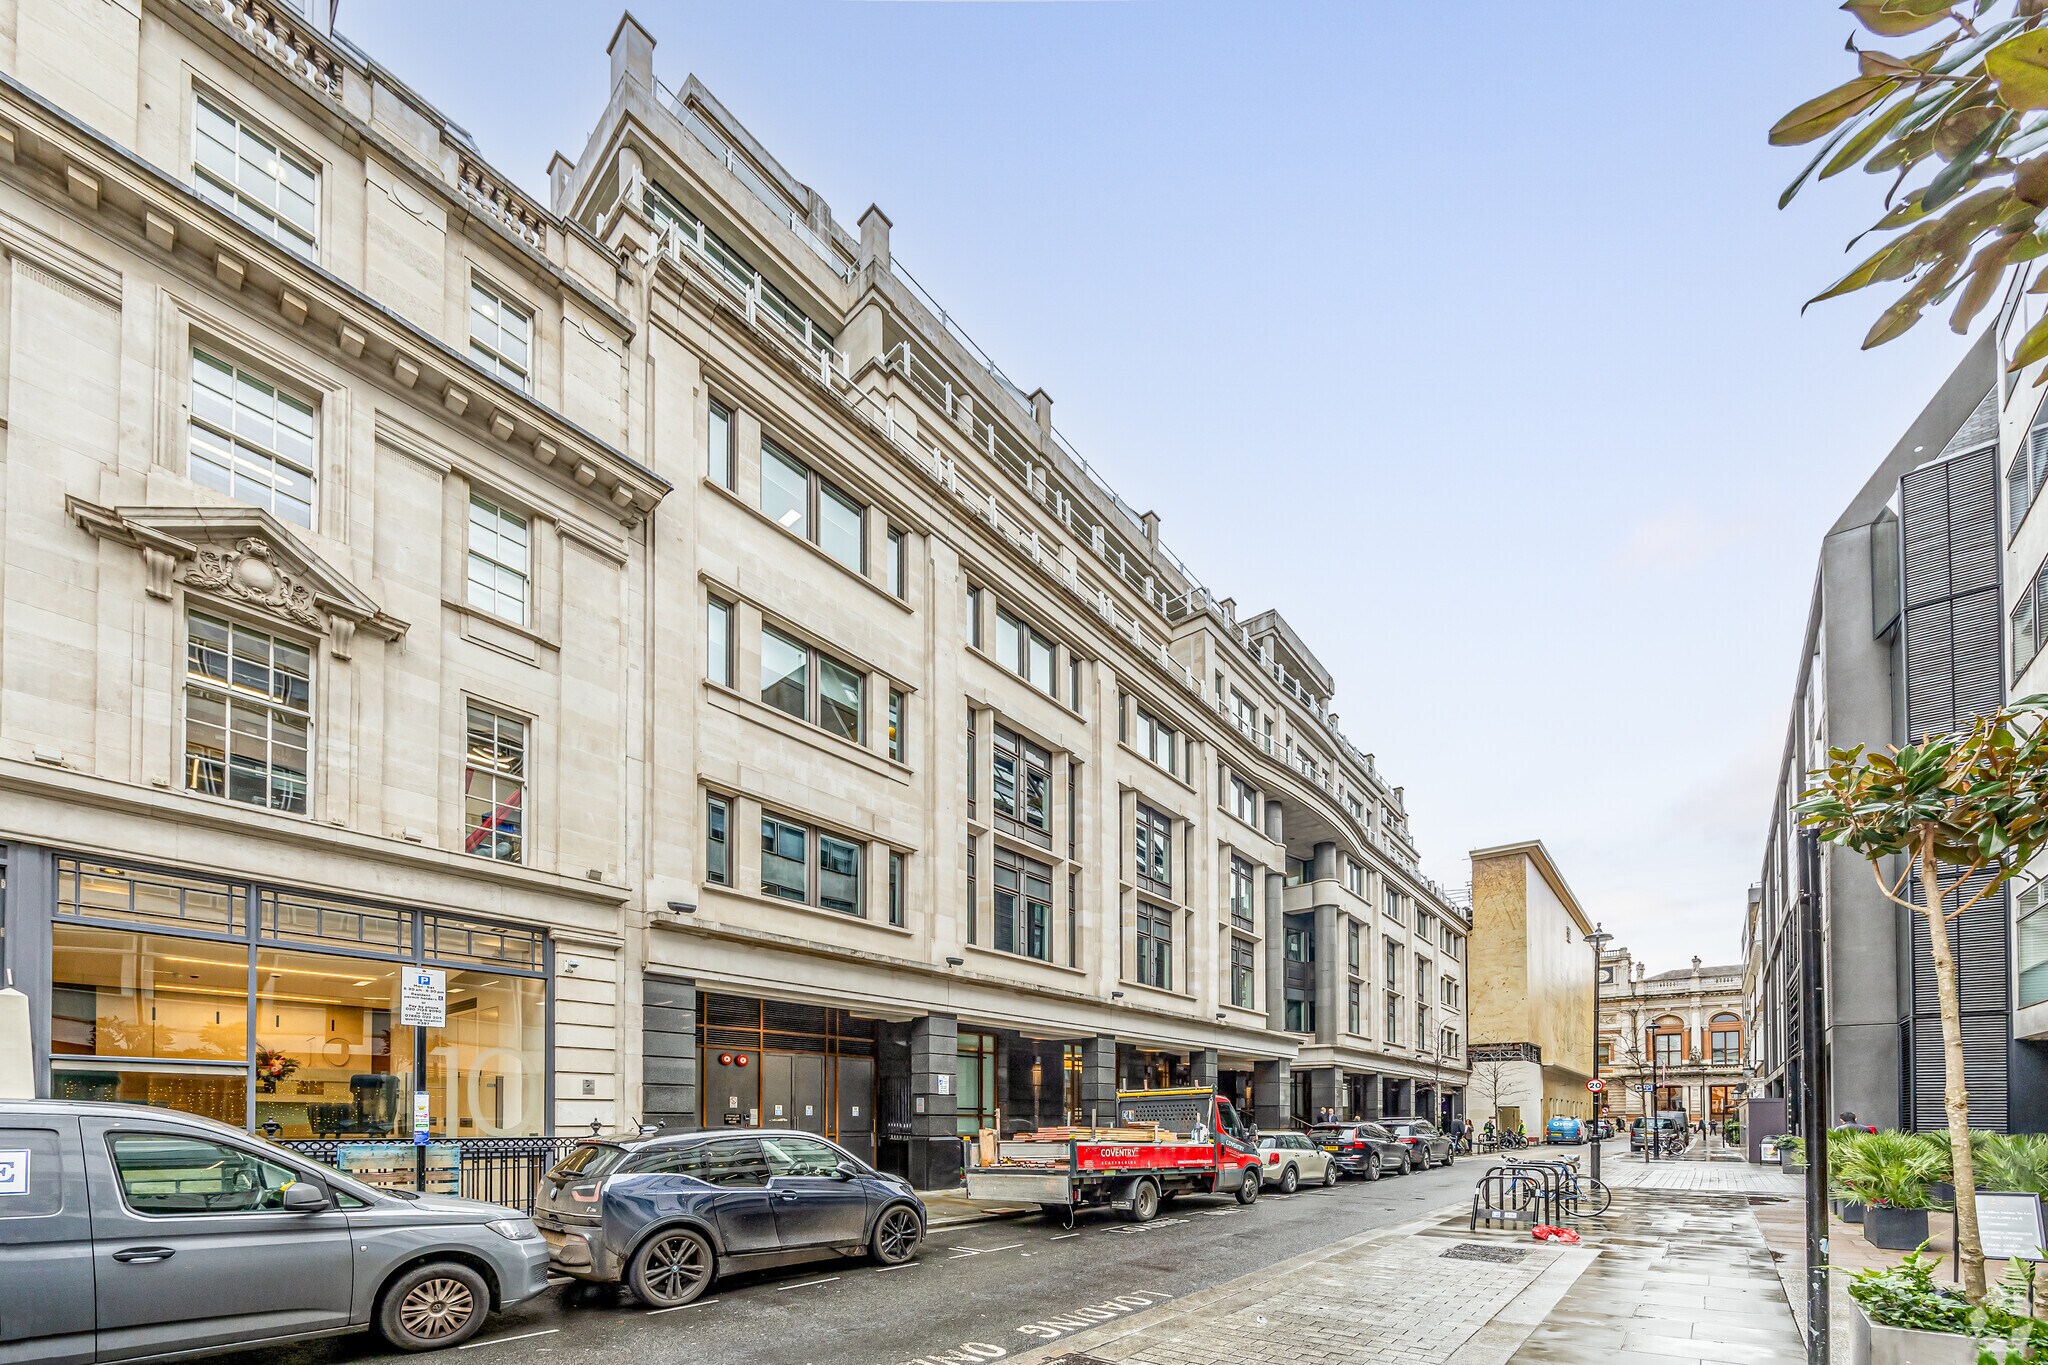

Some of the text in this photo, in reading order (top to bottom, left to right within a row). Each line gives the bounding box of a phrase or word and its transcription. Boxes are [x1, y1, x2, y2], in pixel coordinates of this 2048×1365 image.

[420, 976, 429, 984] P
[429, 1046, 538, 1137] 10
[1100, 1148, 1136, 1158] COVENTRY
[1016, 1289, 1174, 1338] LOADING
